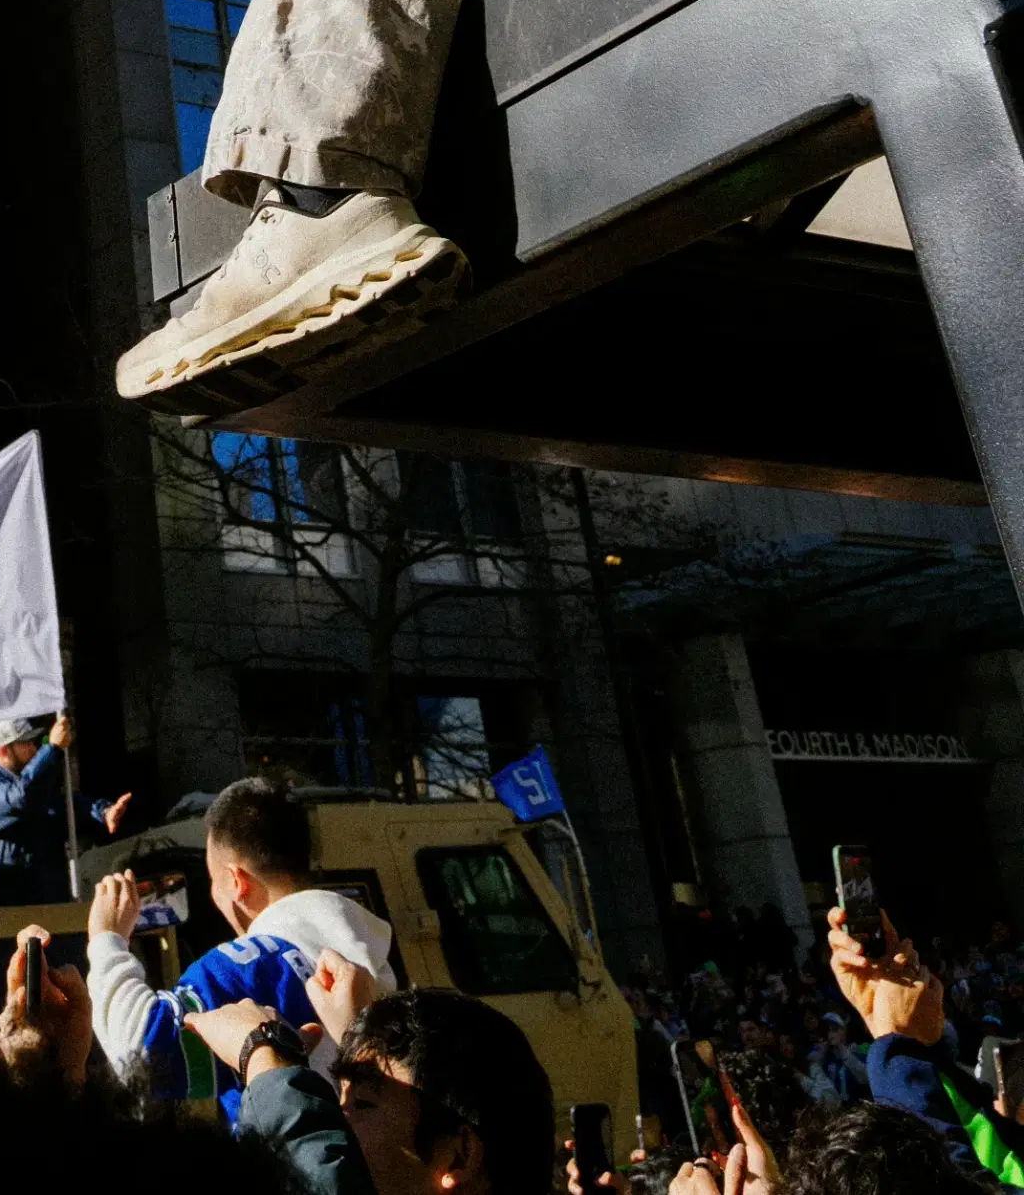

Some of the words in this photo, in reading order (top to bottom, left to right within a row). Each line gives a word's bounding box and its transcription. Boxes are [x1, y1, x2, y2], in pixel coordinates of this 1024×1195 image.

[764, 729, 852, 756] FOURTH
[857, 733, 872, 756] &
[872, 733, 970, 759] MADISON
